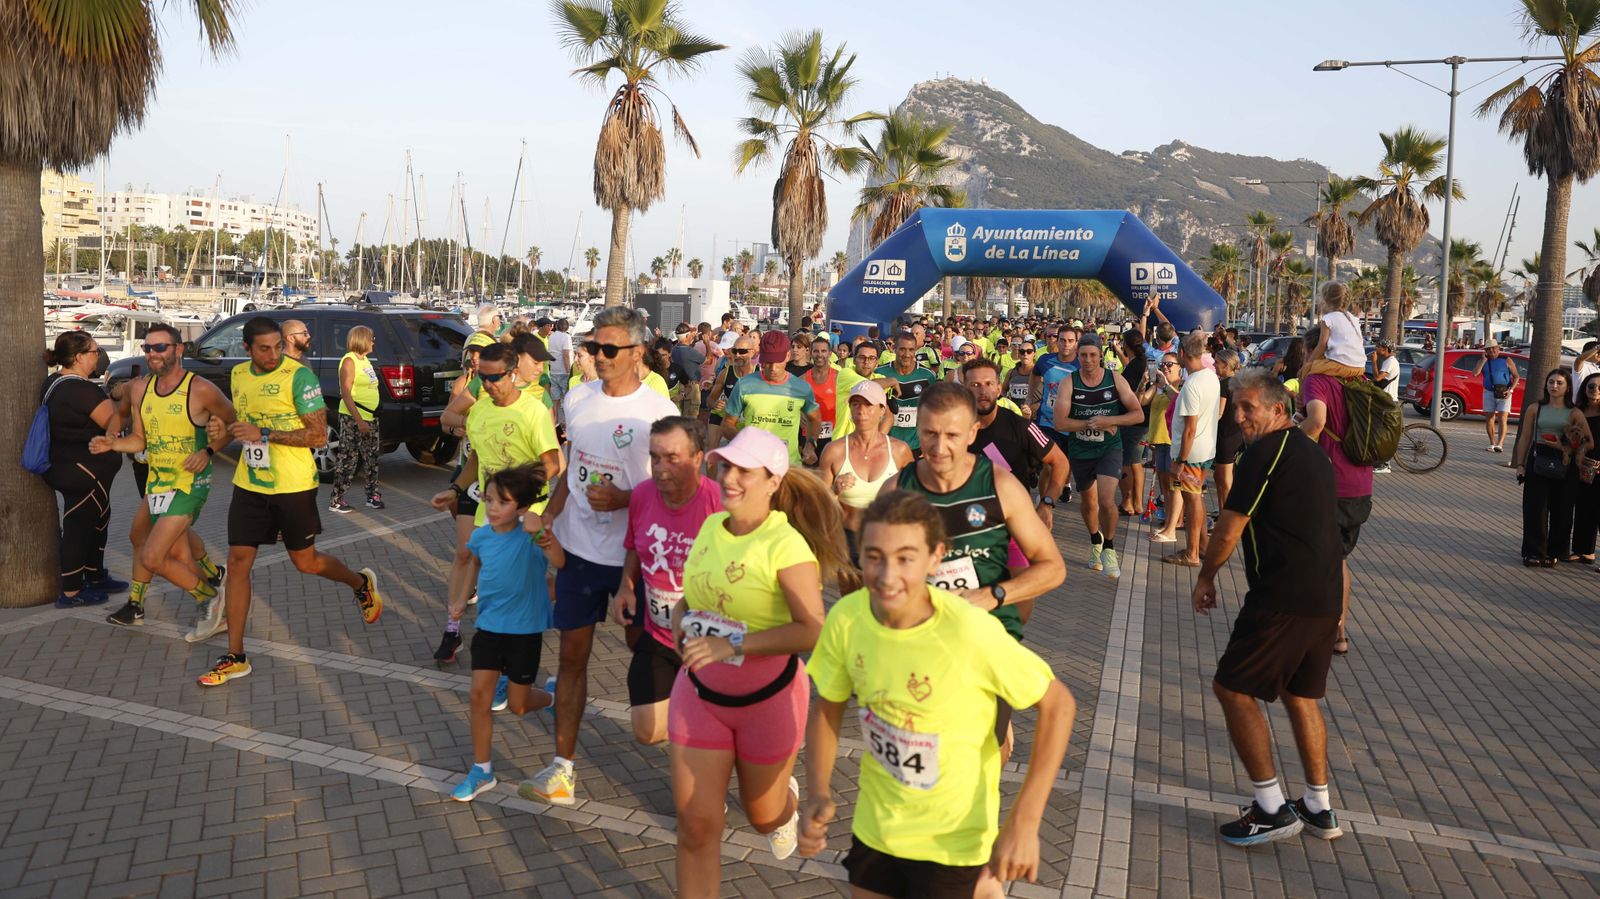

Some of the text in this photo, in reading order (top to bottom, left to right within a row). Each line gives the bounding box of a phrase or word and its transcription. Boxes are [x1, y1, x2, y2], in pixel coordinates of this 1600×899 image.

[972, 226, 1094, 243] Ayuntamiento
[985, 244, 1080, 260] de La Línea
[869, 264, 880, 276] D
[1136, 268, 1148, 280] D
[862, 286, 905, 294] DEPORTES
[898, 414, 911, 422] 50
[245, 448, 263, 461] 19
[152, 496, 166, 507] 17
[870, 731, 925, 774] 584
